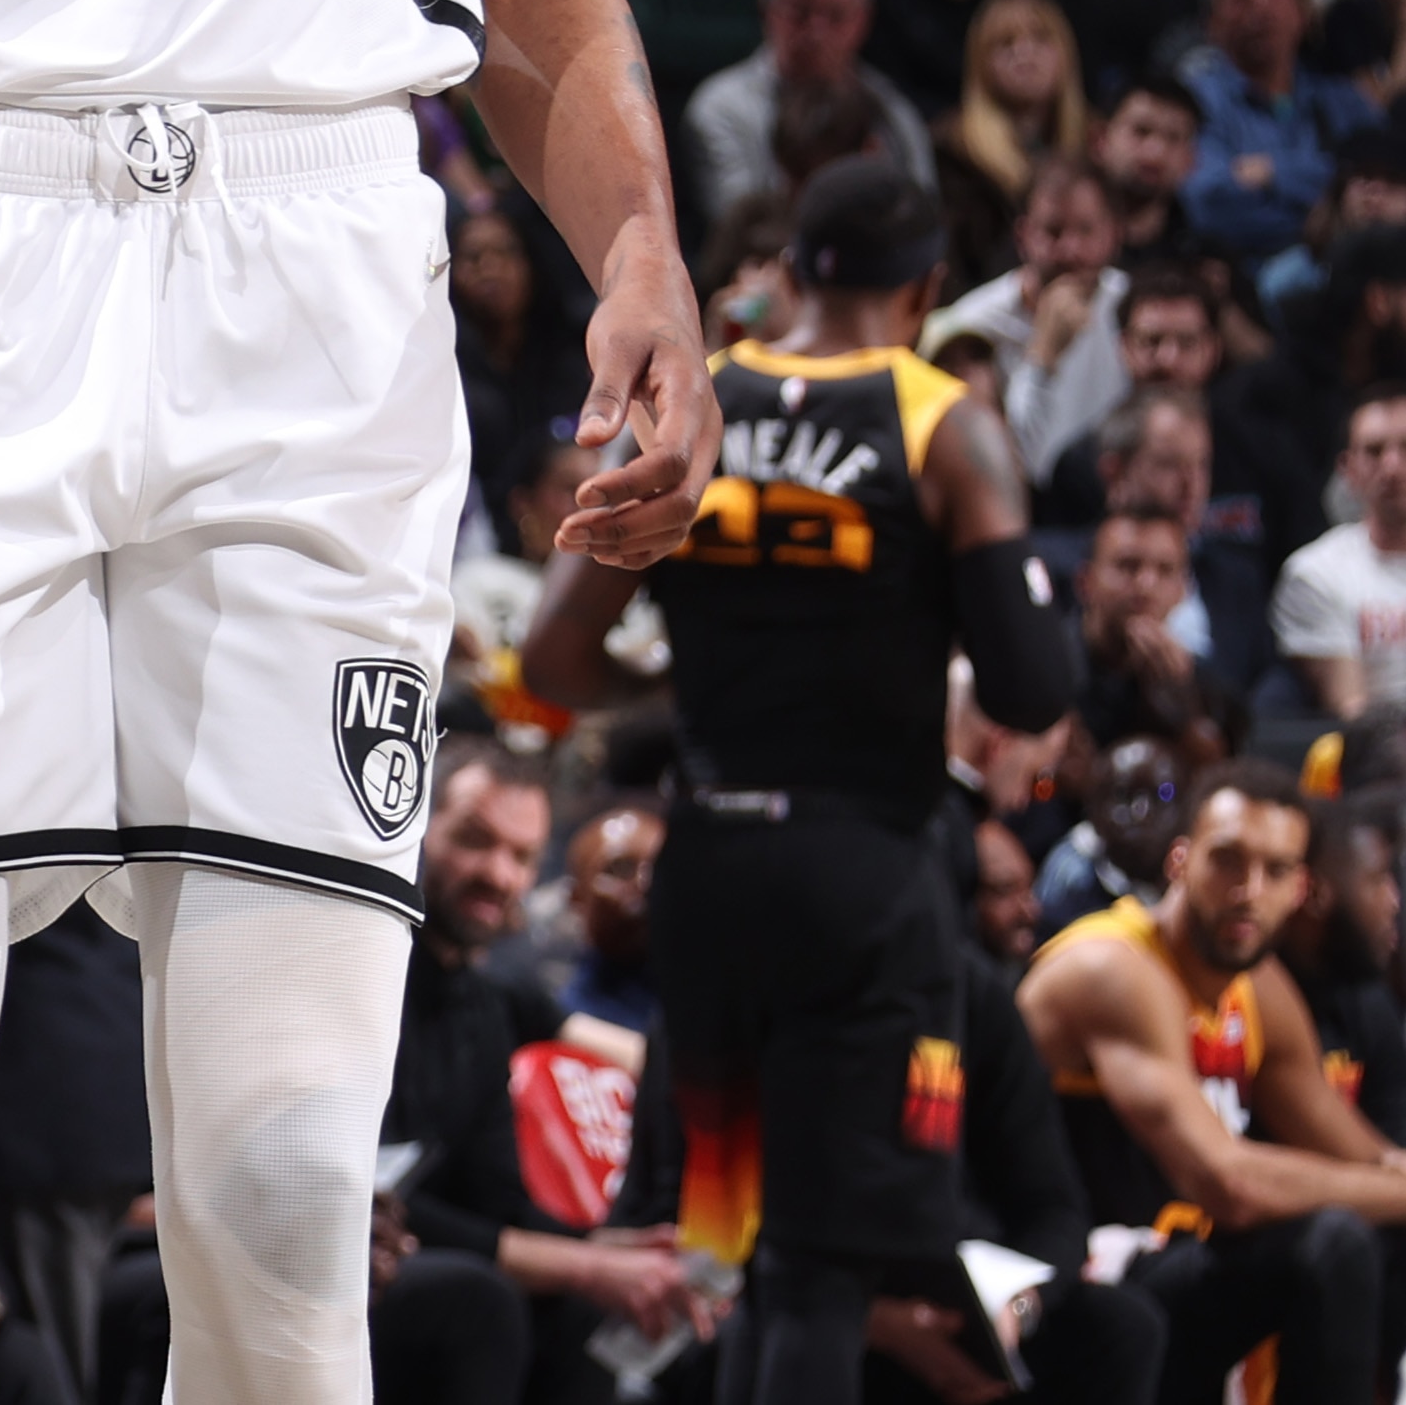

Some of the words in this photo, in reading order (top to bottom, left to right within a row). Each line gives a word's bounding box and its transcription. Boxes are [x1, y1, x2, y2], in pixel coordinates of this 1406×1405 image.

[719, 417, 881, 497] NEALE
[343, 670, 434, 763] NETS
[382, 750, 406, 811] B
